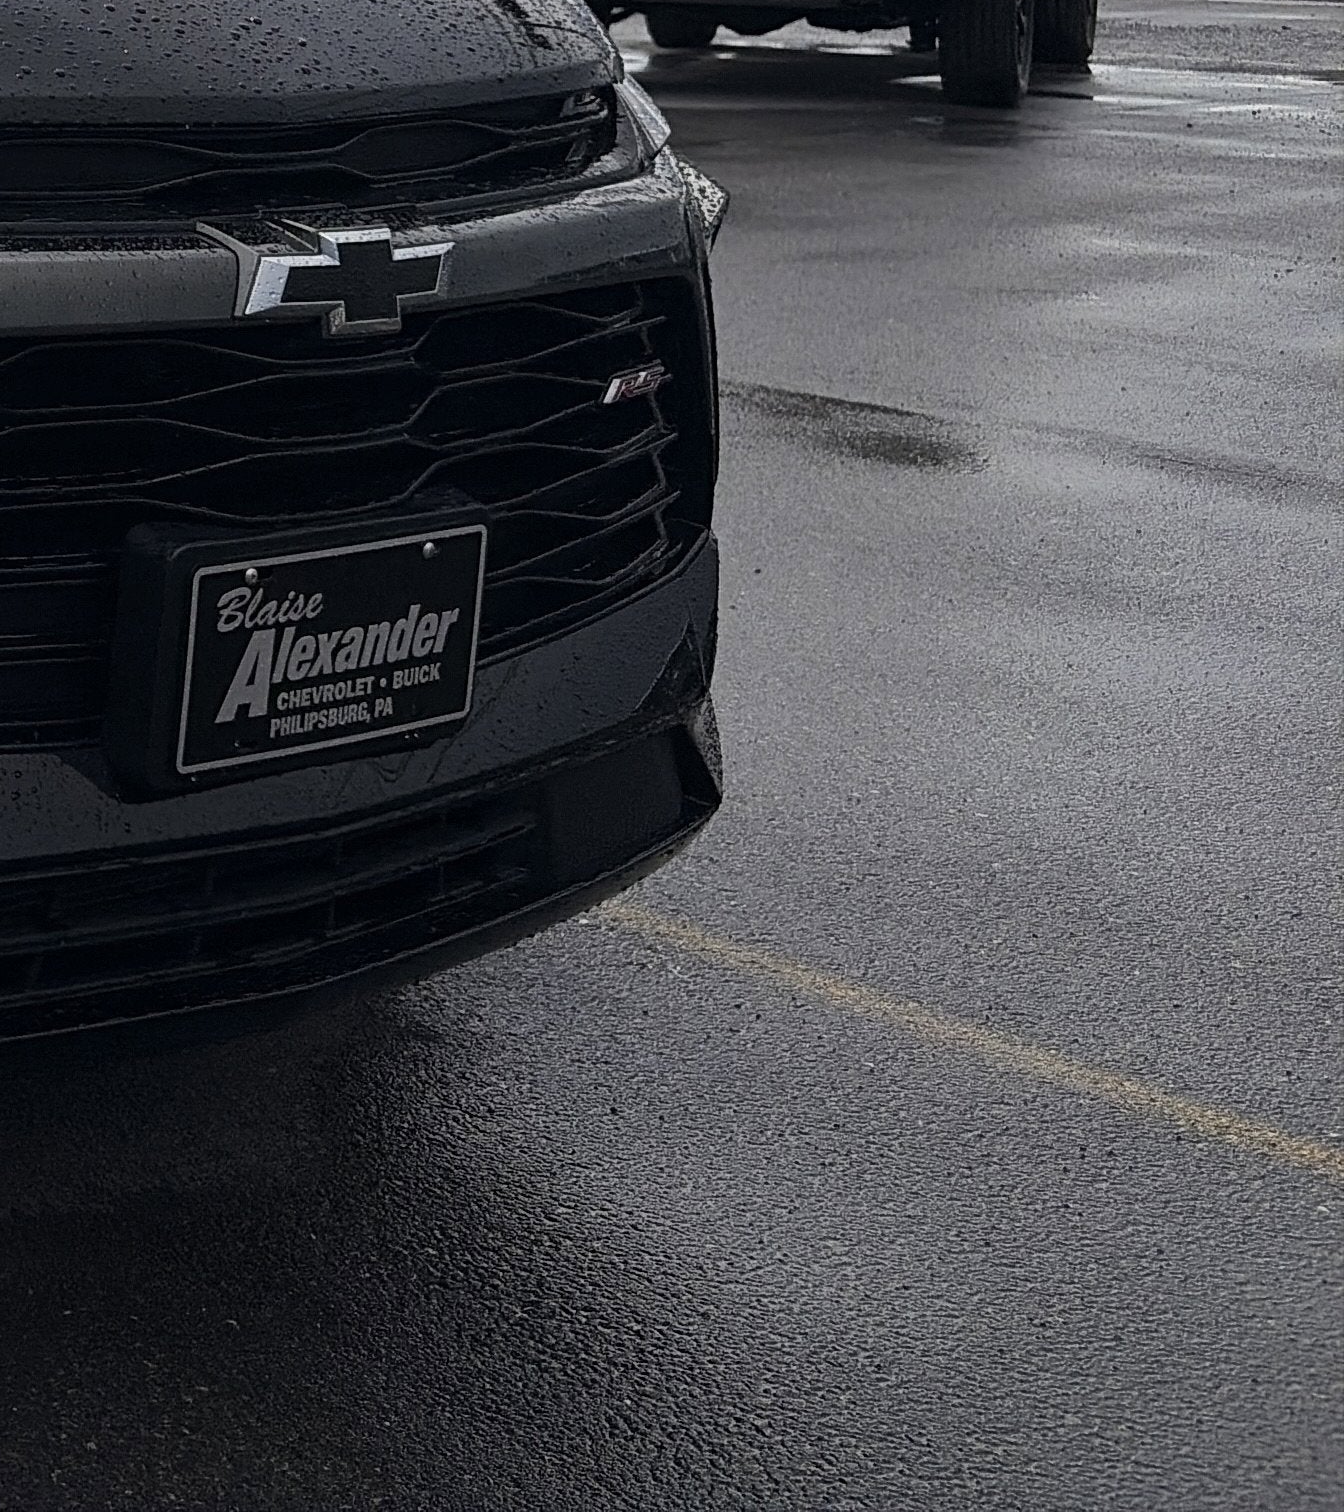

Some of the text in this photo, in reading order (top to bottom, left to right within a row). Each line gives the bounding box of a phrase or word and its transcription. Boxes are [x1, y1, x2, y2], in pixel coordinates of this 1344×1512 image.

[603, 362, 669, 404] RS
[216, 587, 324, 632] Blaise
[214, 604, 461, 724] Alexander
[277, 662, 442, 711] CHEVROLET BUICK
[269, 696, 394, 739] PHILIPSBURG, PA
